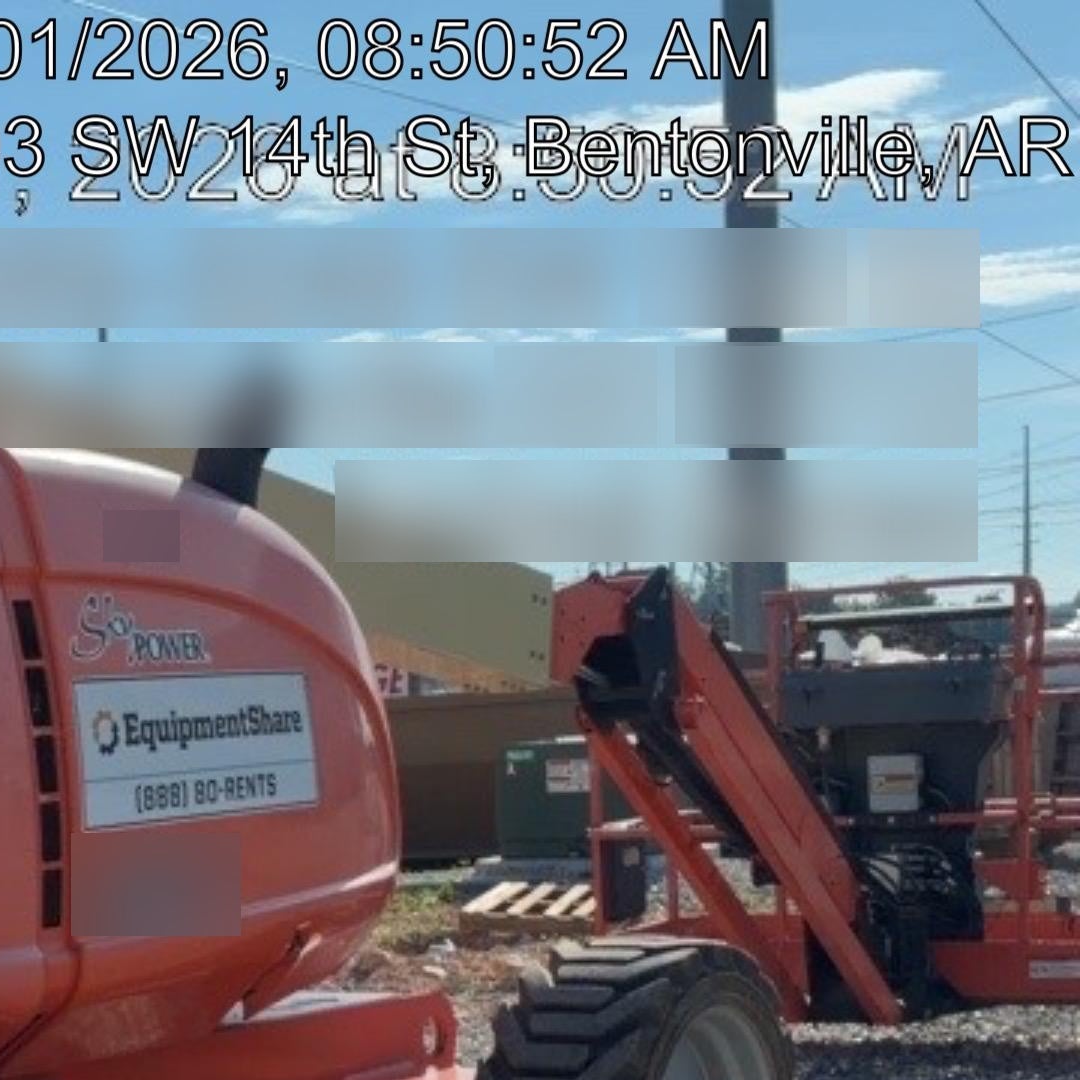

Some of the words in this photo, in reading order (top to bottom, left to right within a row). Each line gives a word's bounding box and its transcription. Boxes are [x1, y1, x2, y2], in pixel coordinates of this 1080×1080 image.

[123, 705, 303, 751] EquipmentShare
[135, 781, 188, 813] (888)
[194, 774, 277, 804] 80-RENTS
